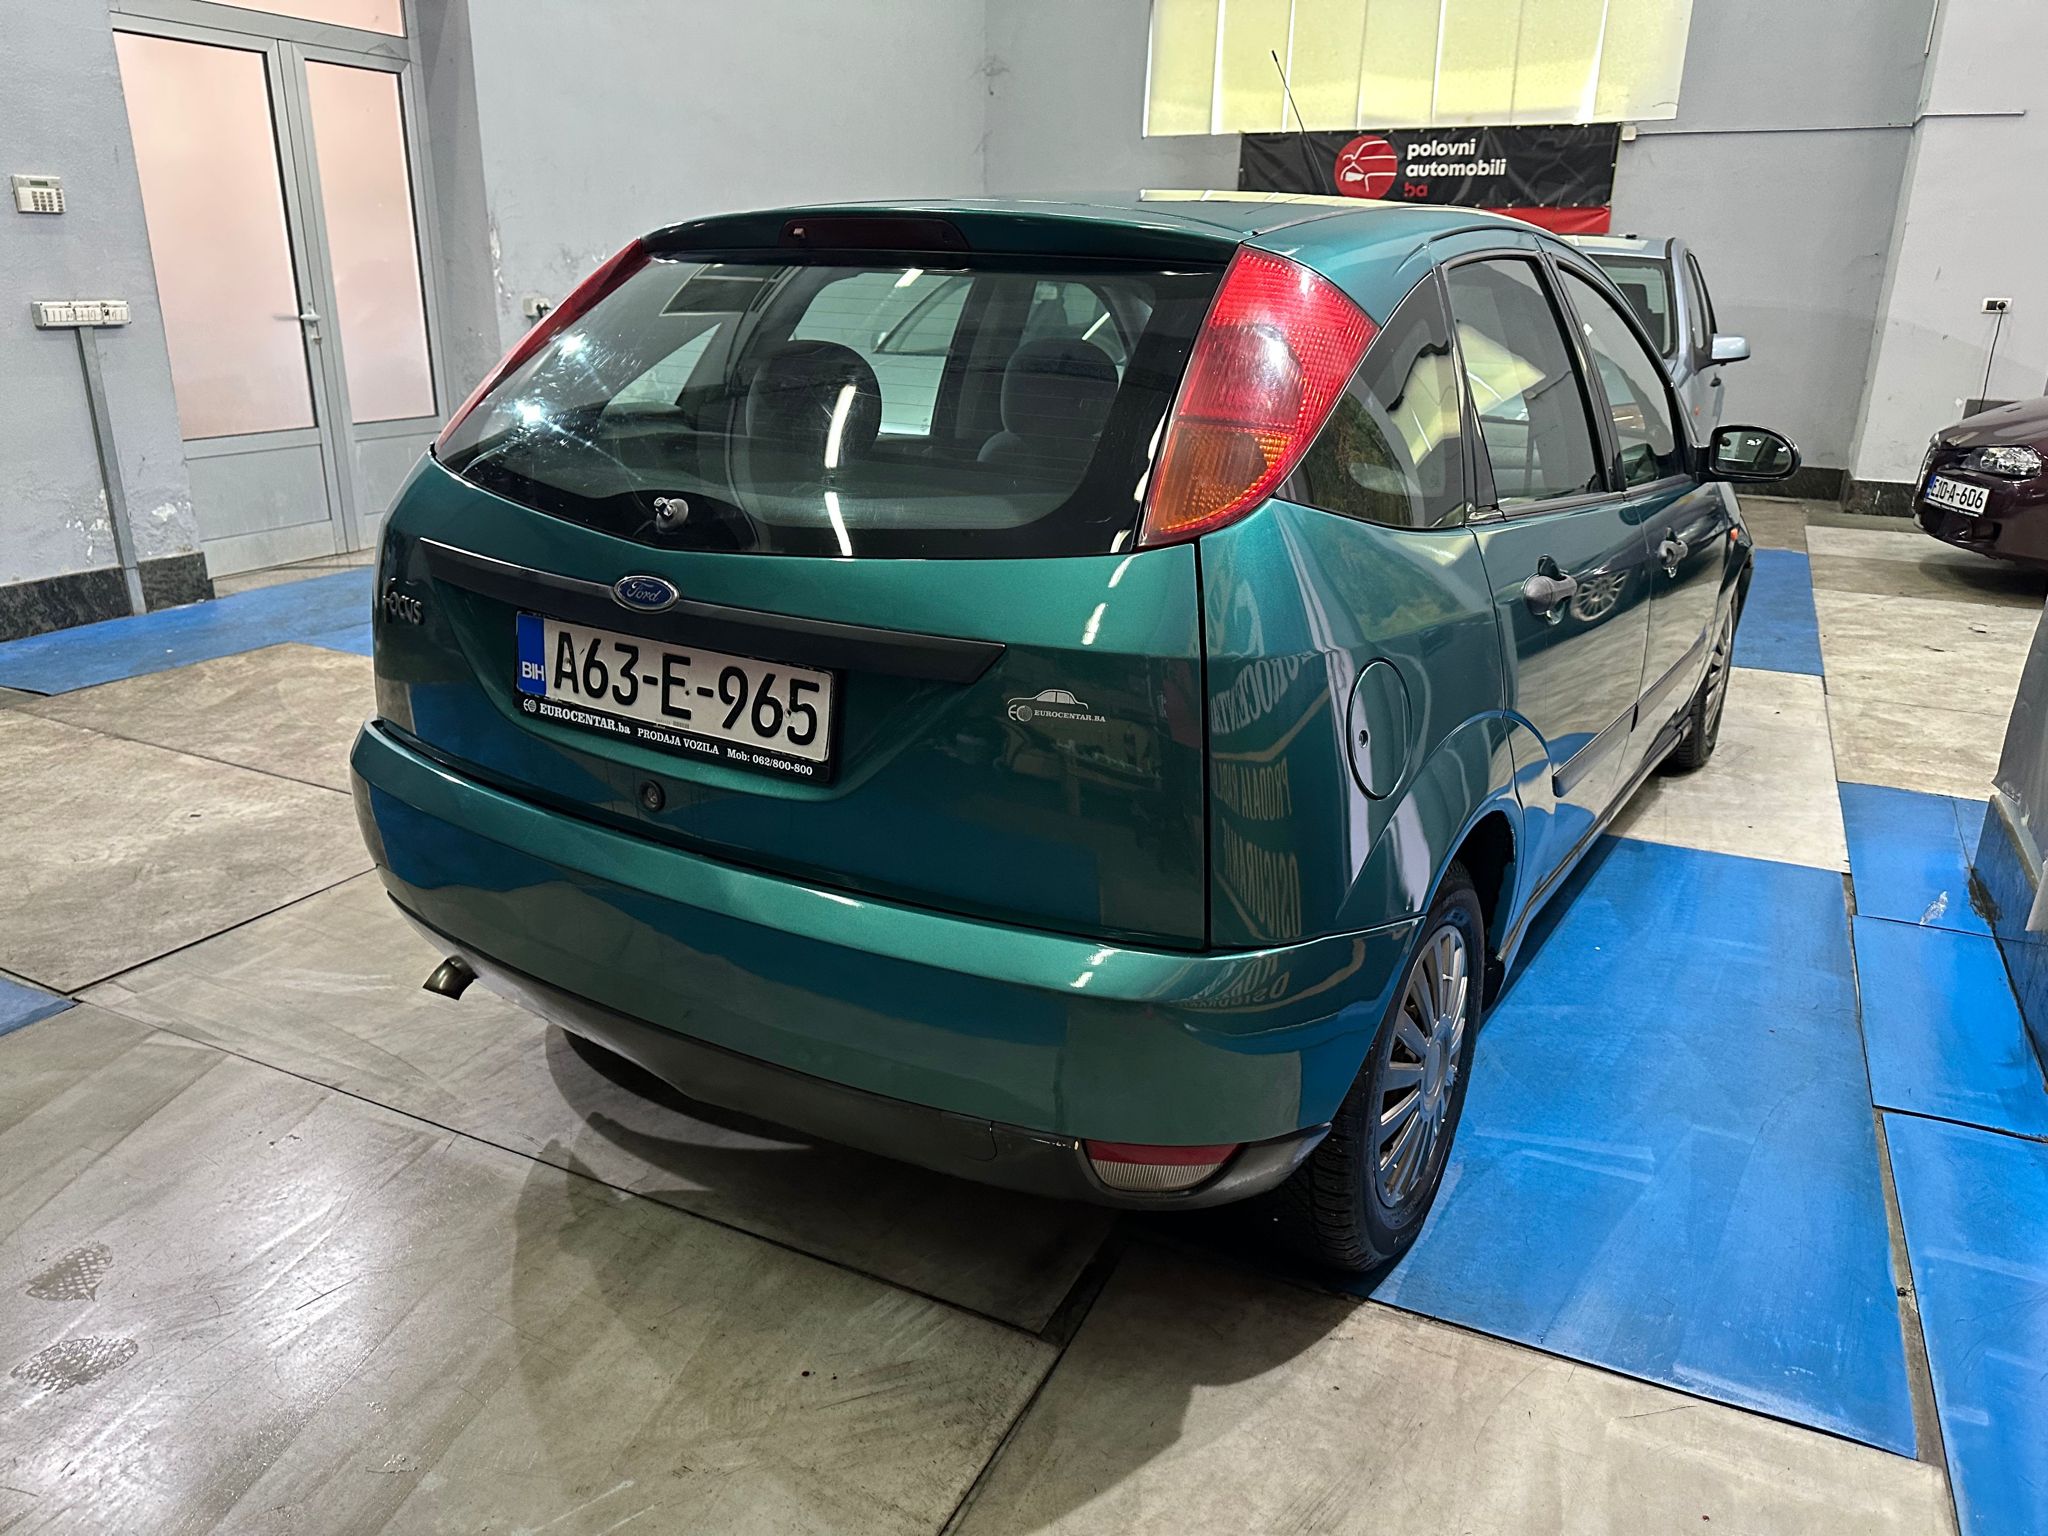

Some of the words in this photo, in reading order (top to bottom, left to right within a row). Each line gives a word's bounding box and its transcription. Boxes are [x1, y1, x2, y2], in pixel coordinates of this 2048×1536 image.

[1407, 138, 1476, 160] polovni
[1405, 159, 1506, 177] automobili
[626, 580, 662, 602] Ford
[521, 661, 545, 682] BIH
[553, 632, 820, 746] A63-E-965
[1034, 709, 1106, 723] EUROCENTAR.BA
[540, 703, 631, 735] EUROCENTAR.ba
[637, 727, 682, 747] PRODAJA
[683, 738, 719, 755] VOZILA
[727, 748, 750, 762] Mob:
[752, 754, 813, 776] 062/800-800
